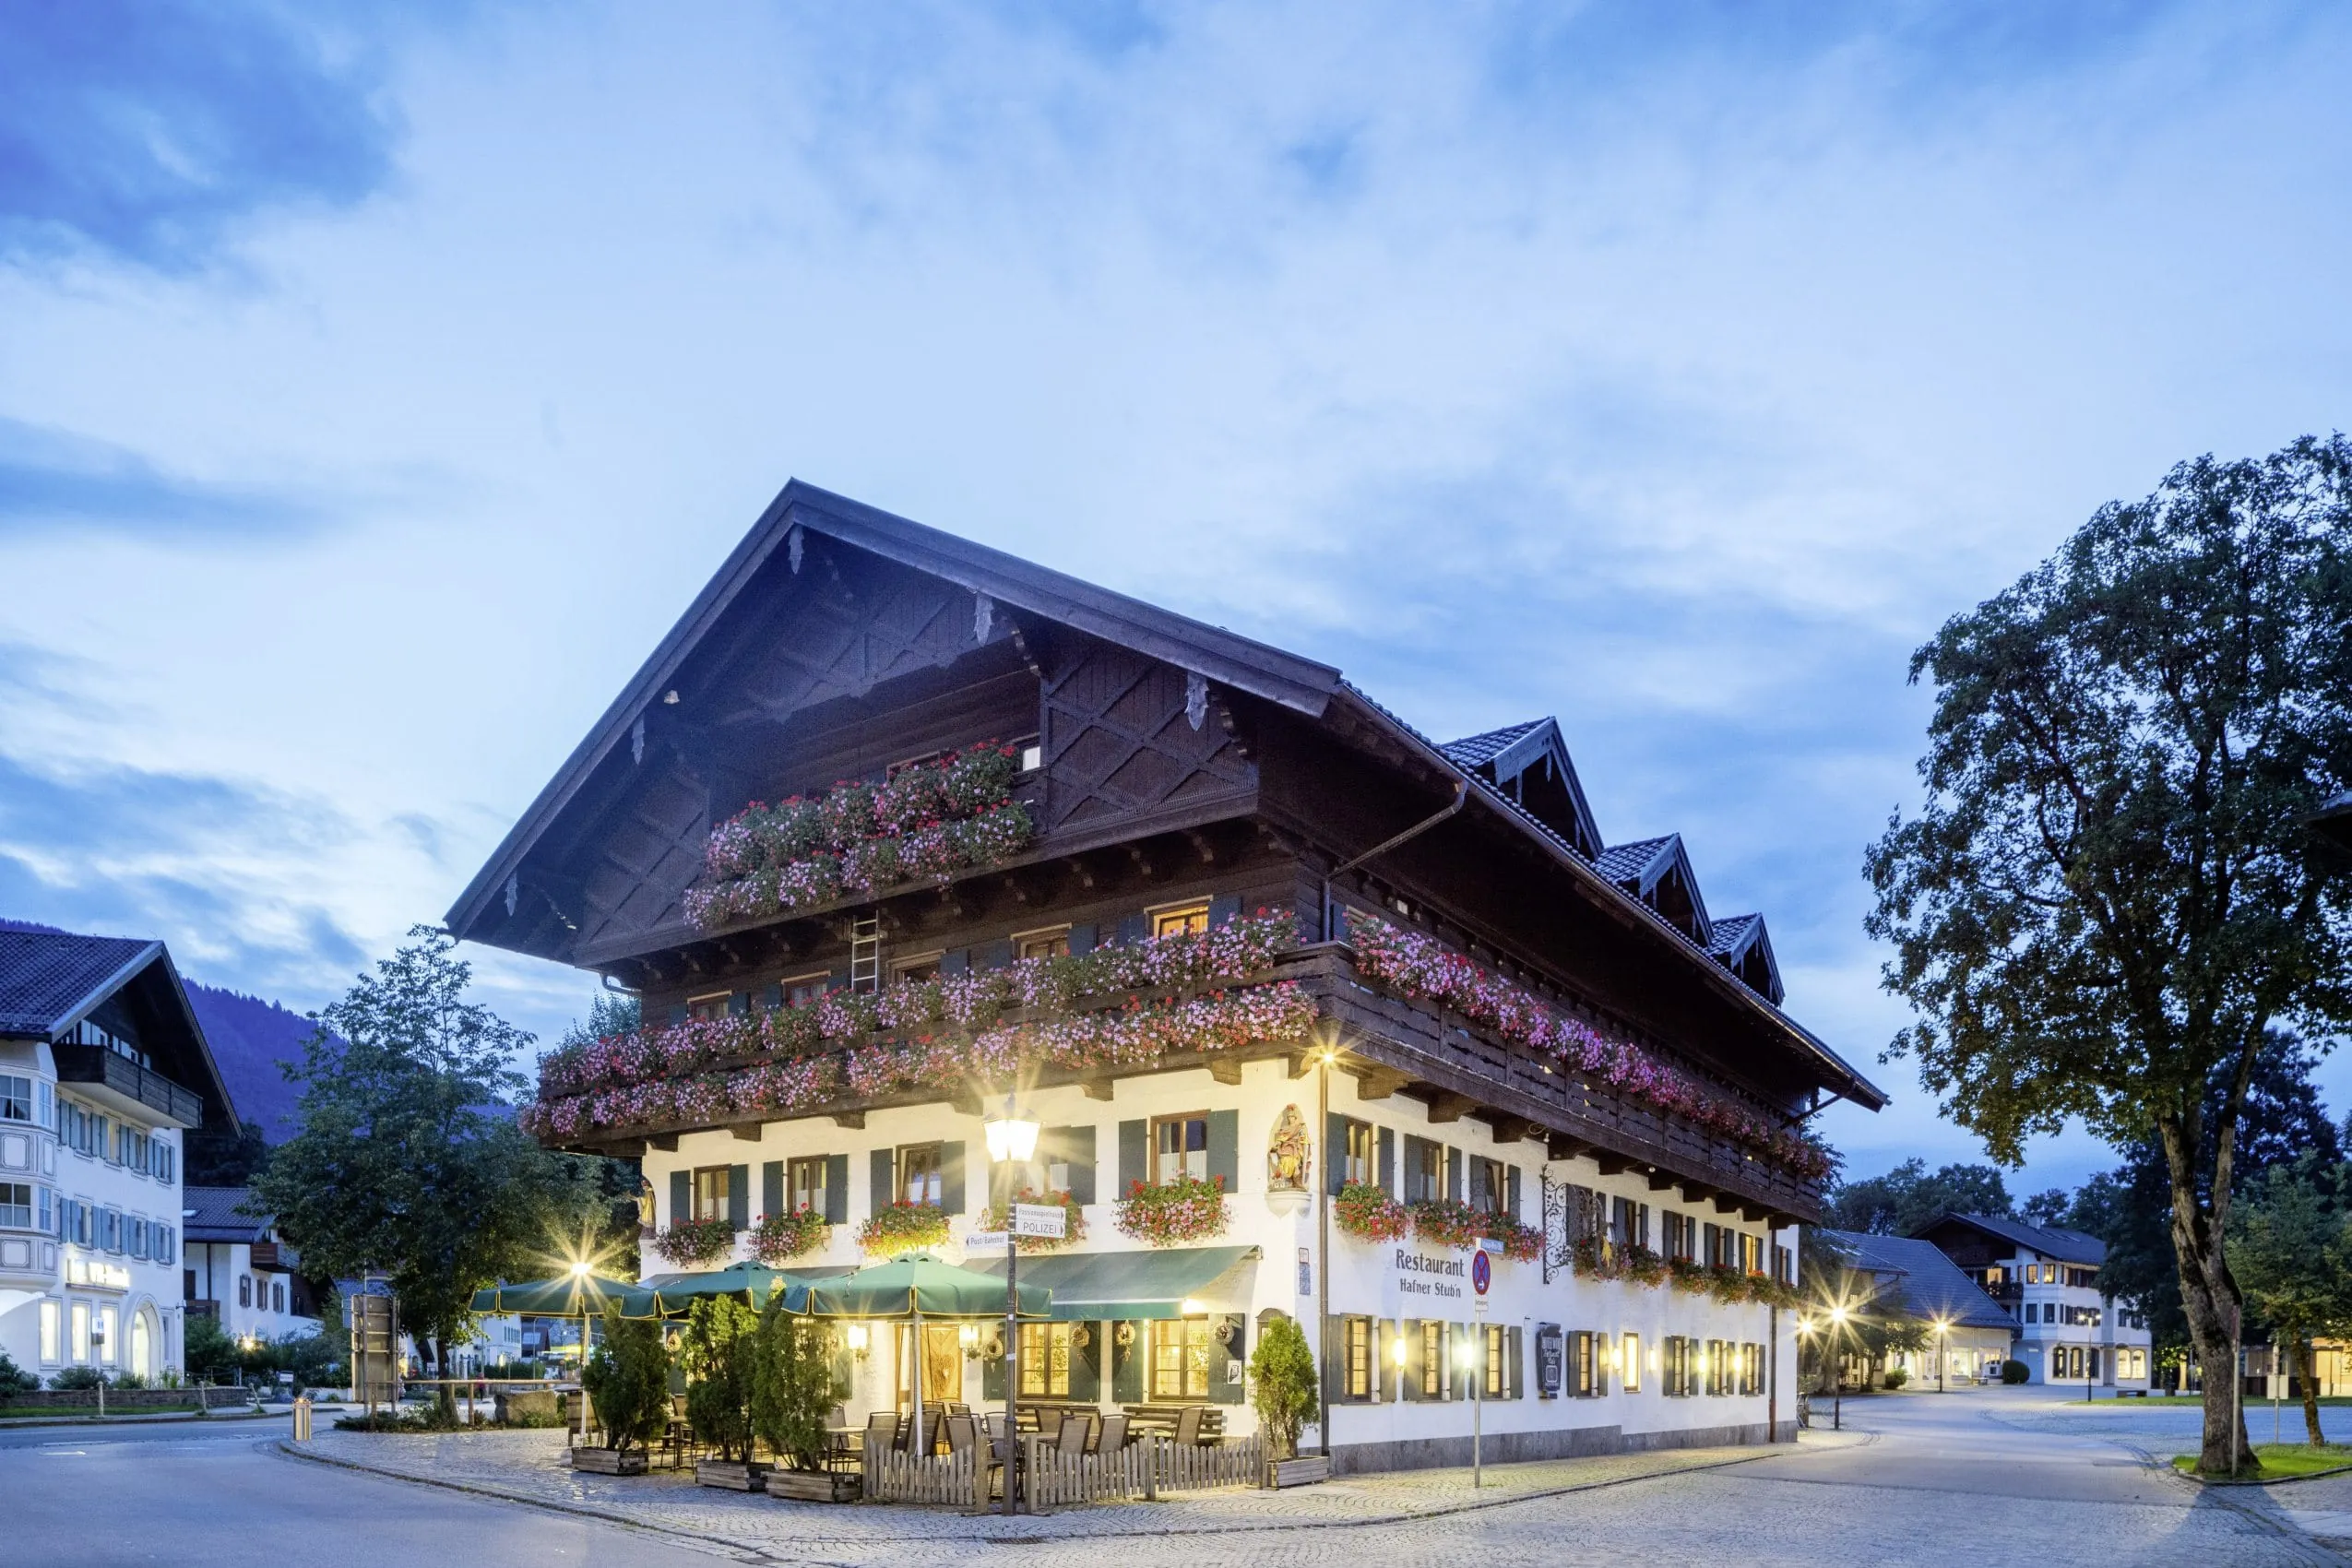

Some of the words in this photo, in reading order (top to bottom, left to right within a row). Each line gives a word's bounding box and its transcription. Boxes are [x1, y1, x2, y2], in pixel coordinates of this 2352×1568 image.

[1023, 1222, 1057, 1234] POLIZEI
[1396, 1249, 1465, 1277] Restaurant
[1399, 1277, 1431, 1295] Hafner
